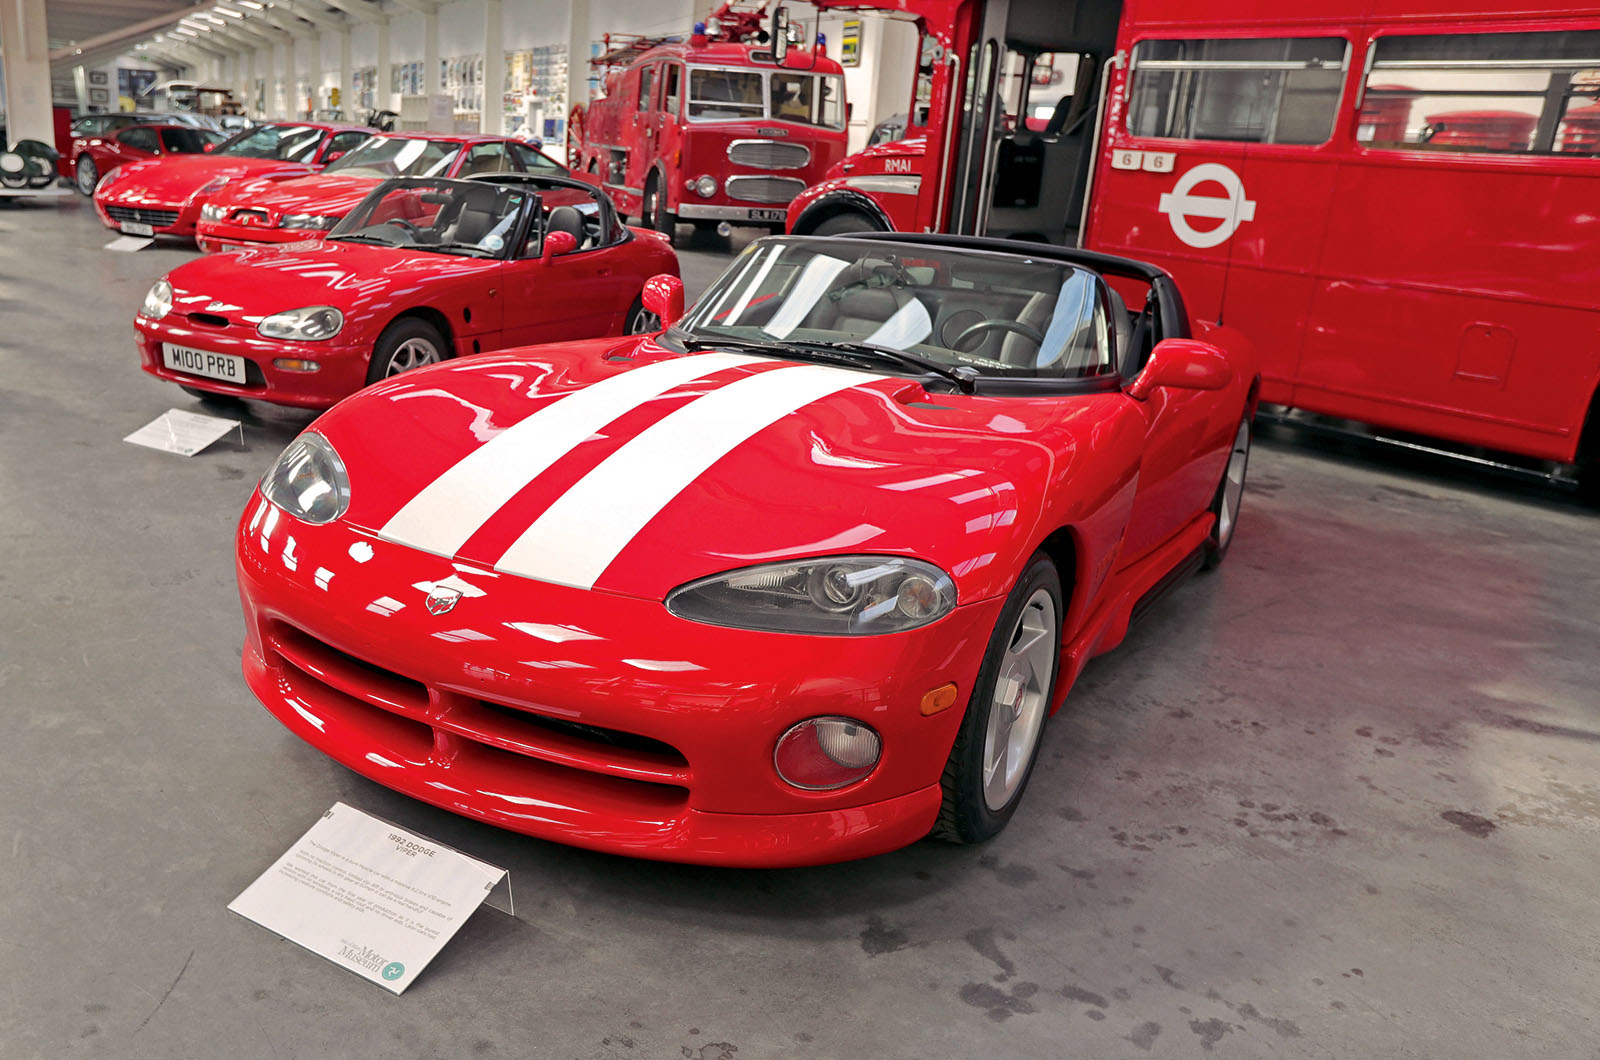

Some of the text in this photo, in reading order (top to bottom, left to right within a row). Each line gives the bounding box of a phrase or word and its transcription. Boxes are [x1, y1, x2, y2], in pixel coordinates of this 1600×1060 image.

[171, 347, 236, 377] M100 PRB
[388, 833, 437, 858] 1992 DODGE
[395, 844, 418, 858] VIPER
[338, 945, 381, 973] Museum
[357, 946, 389, 967] Motor
